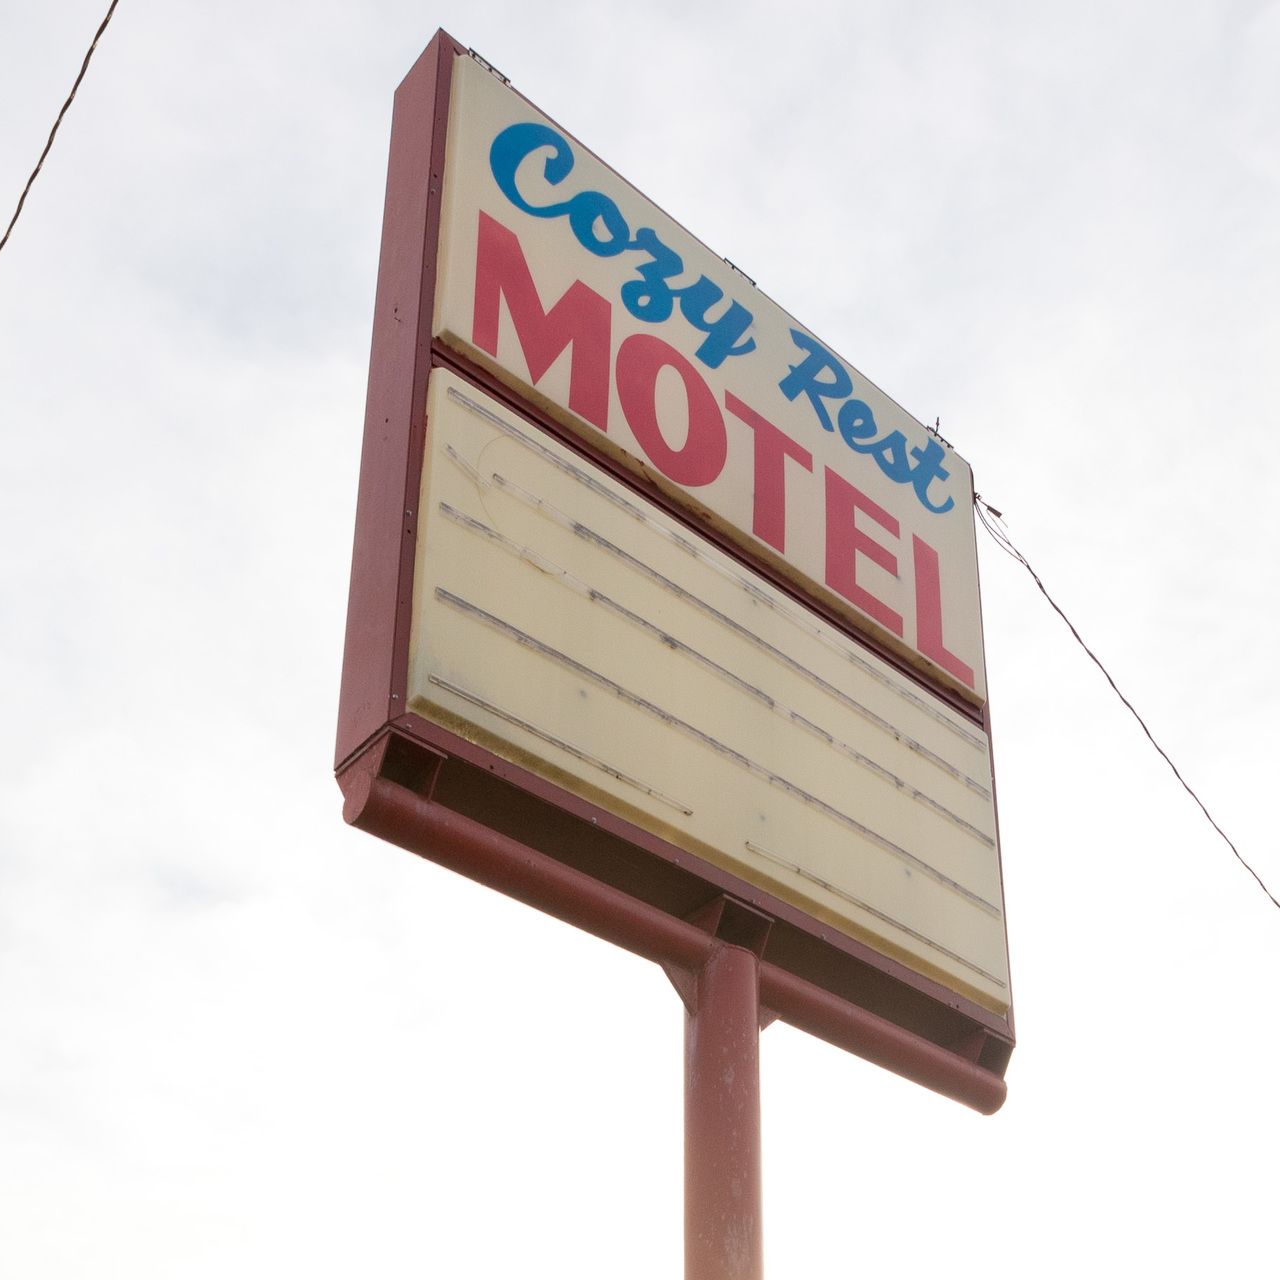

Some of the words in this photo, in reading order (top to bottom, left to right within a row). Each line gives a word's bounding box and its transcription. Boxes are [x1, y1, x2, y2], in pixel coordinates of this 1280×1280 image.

[472, 209, 975, 690] MOTEL
[489, 122, 756, 370] Cozy
[779, 328, 955, 514] Rest
